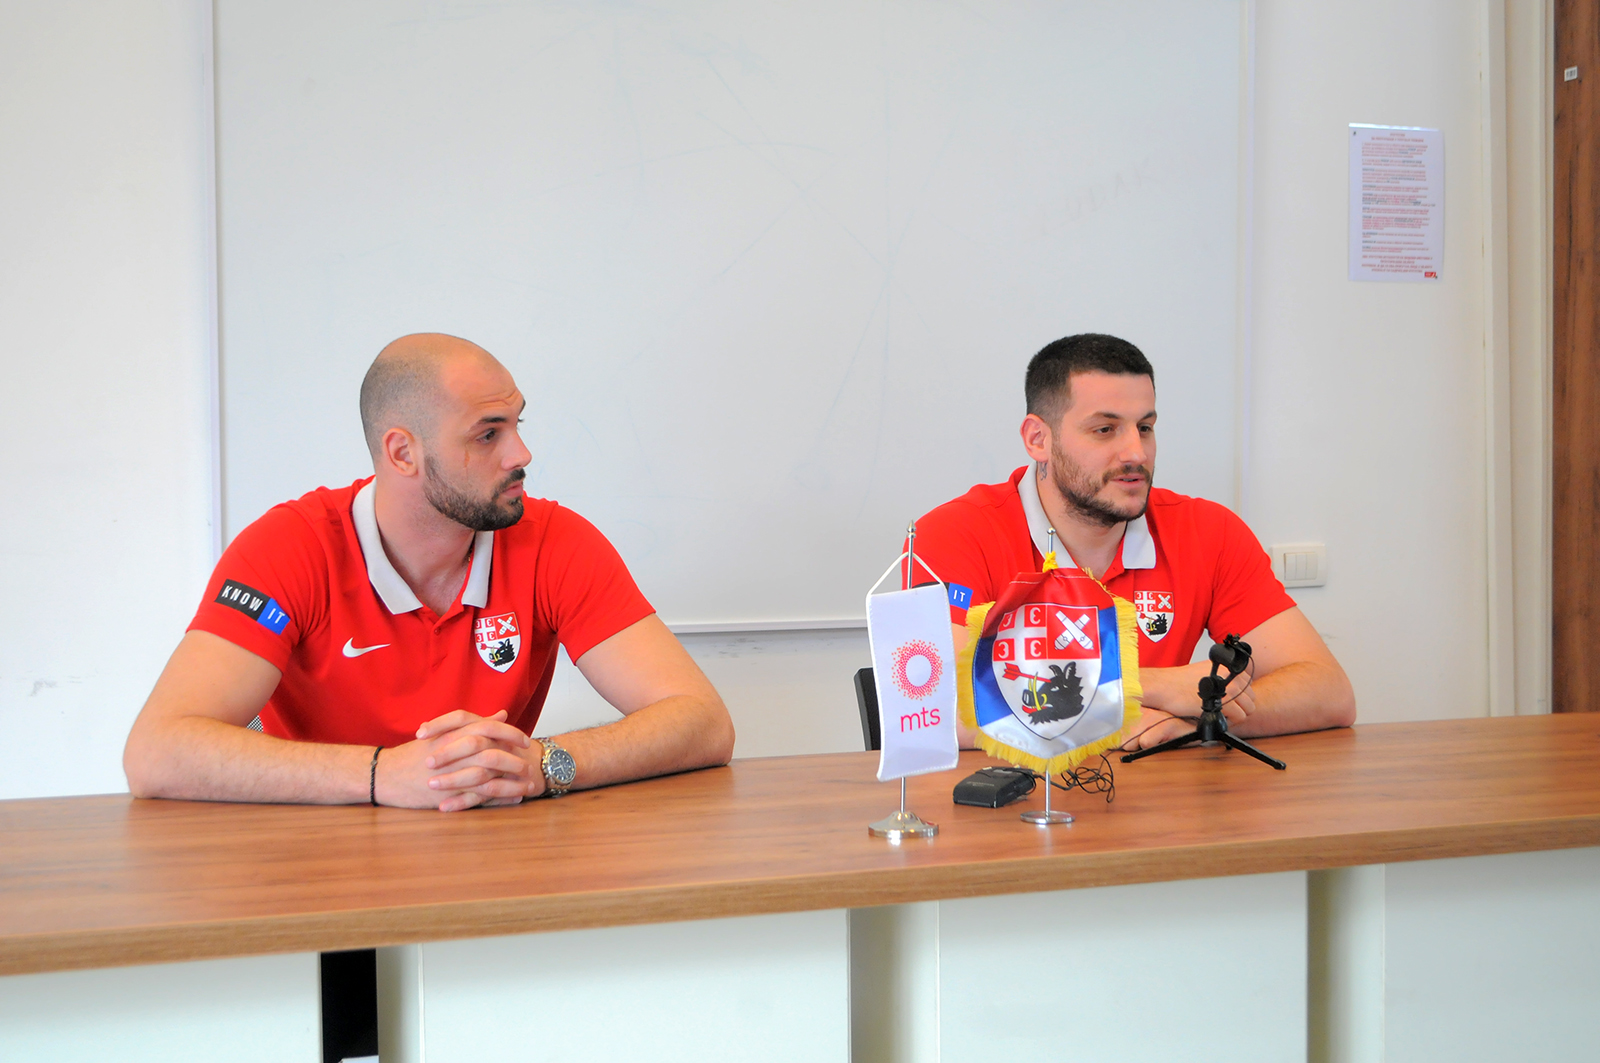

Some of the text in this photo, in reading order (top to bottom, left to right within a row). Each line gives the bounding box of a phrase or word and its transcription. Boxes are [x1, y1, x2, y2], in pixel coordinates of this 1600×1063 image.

[221, 585, 286, 624] KNOW IT
[953, 589, 966, 602] IT
[900, 706, 941, 733] mts
